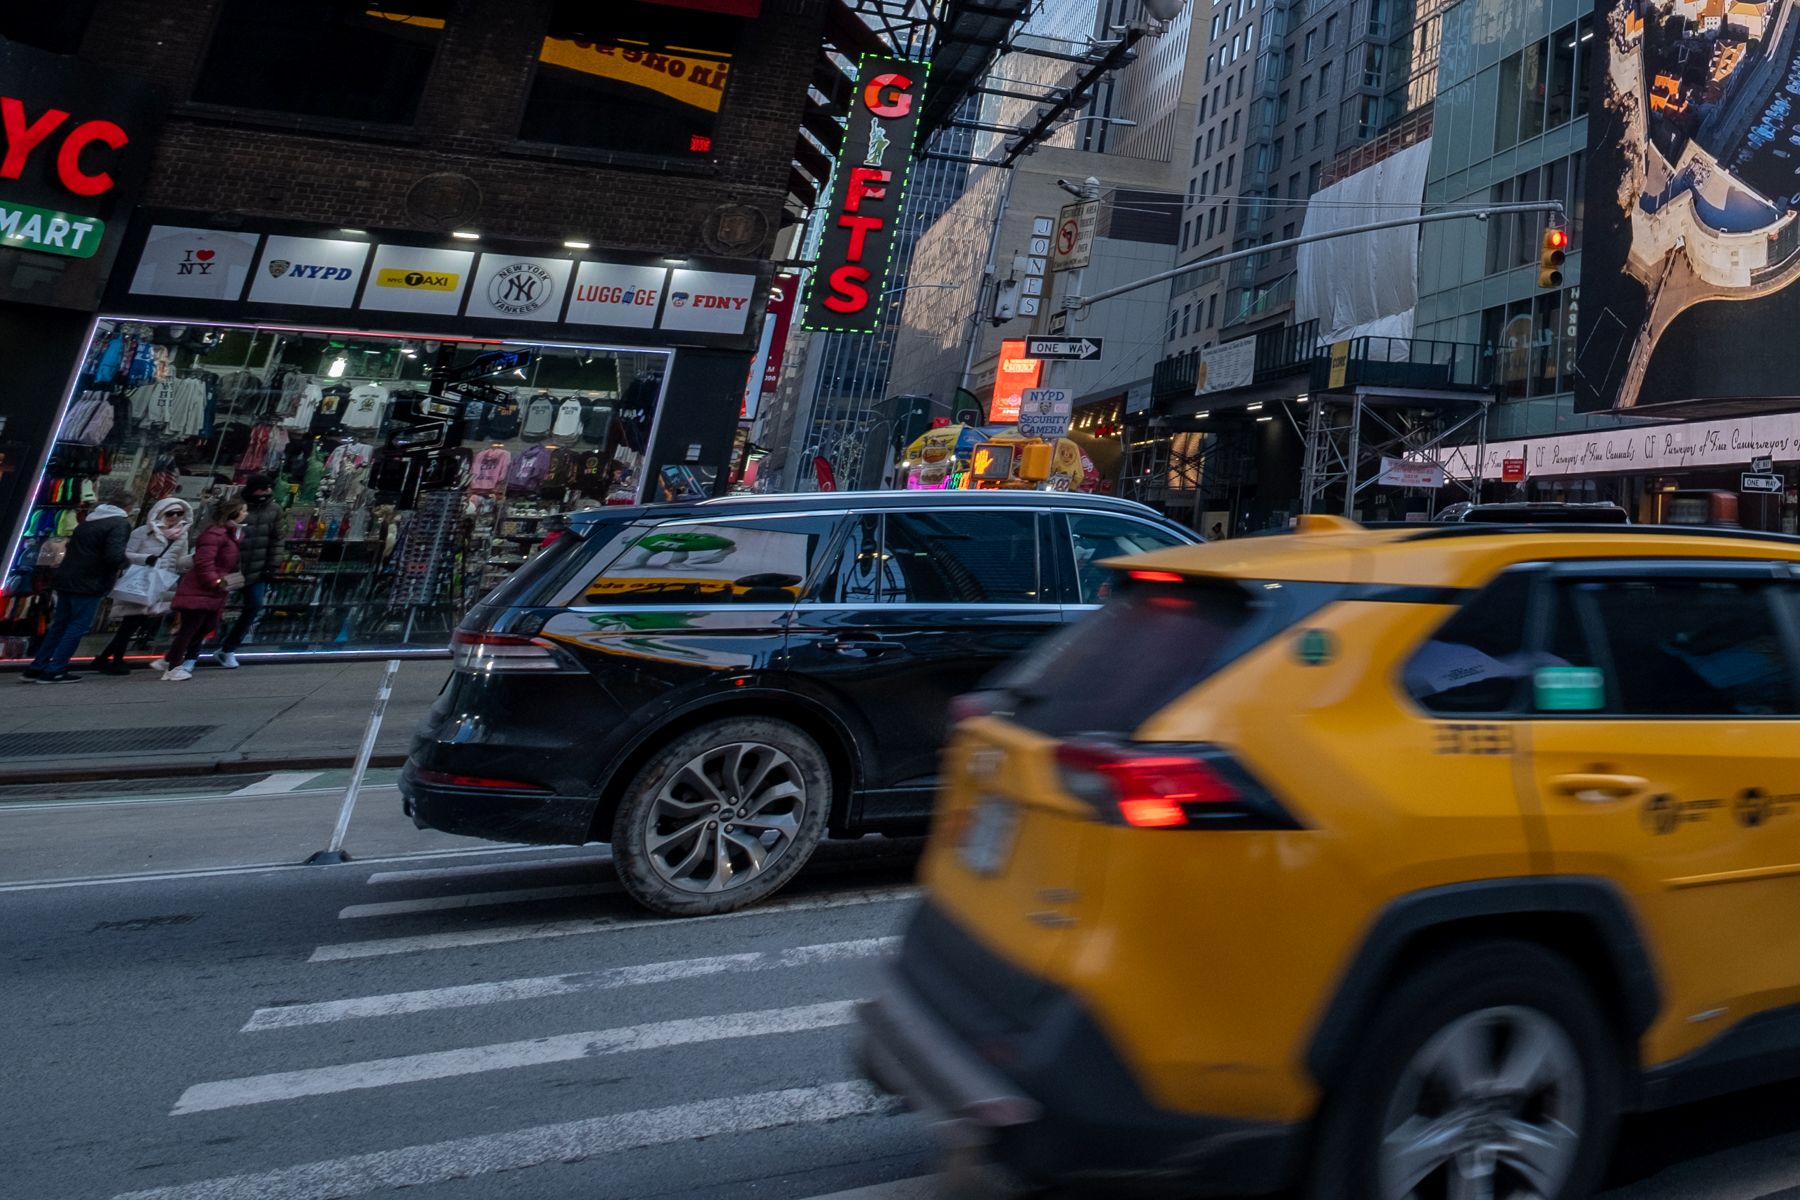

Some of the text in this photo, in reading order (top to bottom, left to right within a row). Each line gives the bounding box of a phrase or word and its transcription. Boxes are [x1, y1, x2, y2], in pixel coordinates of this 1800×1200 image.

[0, 96, 128, 197] YC
[823, 73, 913, 314] GFTS
[177, 263, 215, 274] NY
[289, 264, 352, 280] NYPD
[498, 263, 549, 281] NEW YORK
[1025, 221, 1049, 313] JONES
[407, 273, 448, 286] TAXI
[577, 284, 657, 306] LUGGGE
[693, 294, 748, 310] FDNY
[494, 299, 539, 314] YANKEES
[1037, 343, 1091, 353] ONE WAY
[1030, 391, 1065, 401] NYPD
[1021, 415, 1068, 424] SECURITY
[1021, 424, 1064, 434] CAMERA
[1553, 445, 1579, 474] Purveyors
[1580, 441, 1590, 464] of
[1589, 442, 1603, 461] Fine
[1605, 438, 1636, 461] Cannabis
[1664, 433, 1697, 465] Purveyors
[1699, 430, 1711, 455] of
[1710, 430, 1727, 452] Fine
[1746, 478, 1778, 488] ONE WAY
